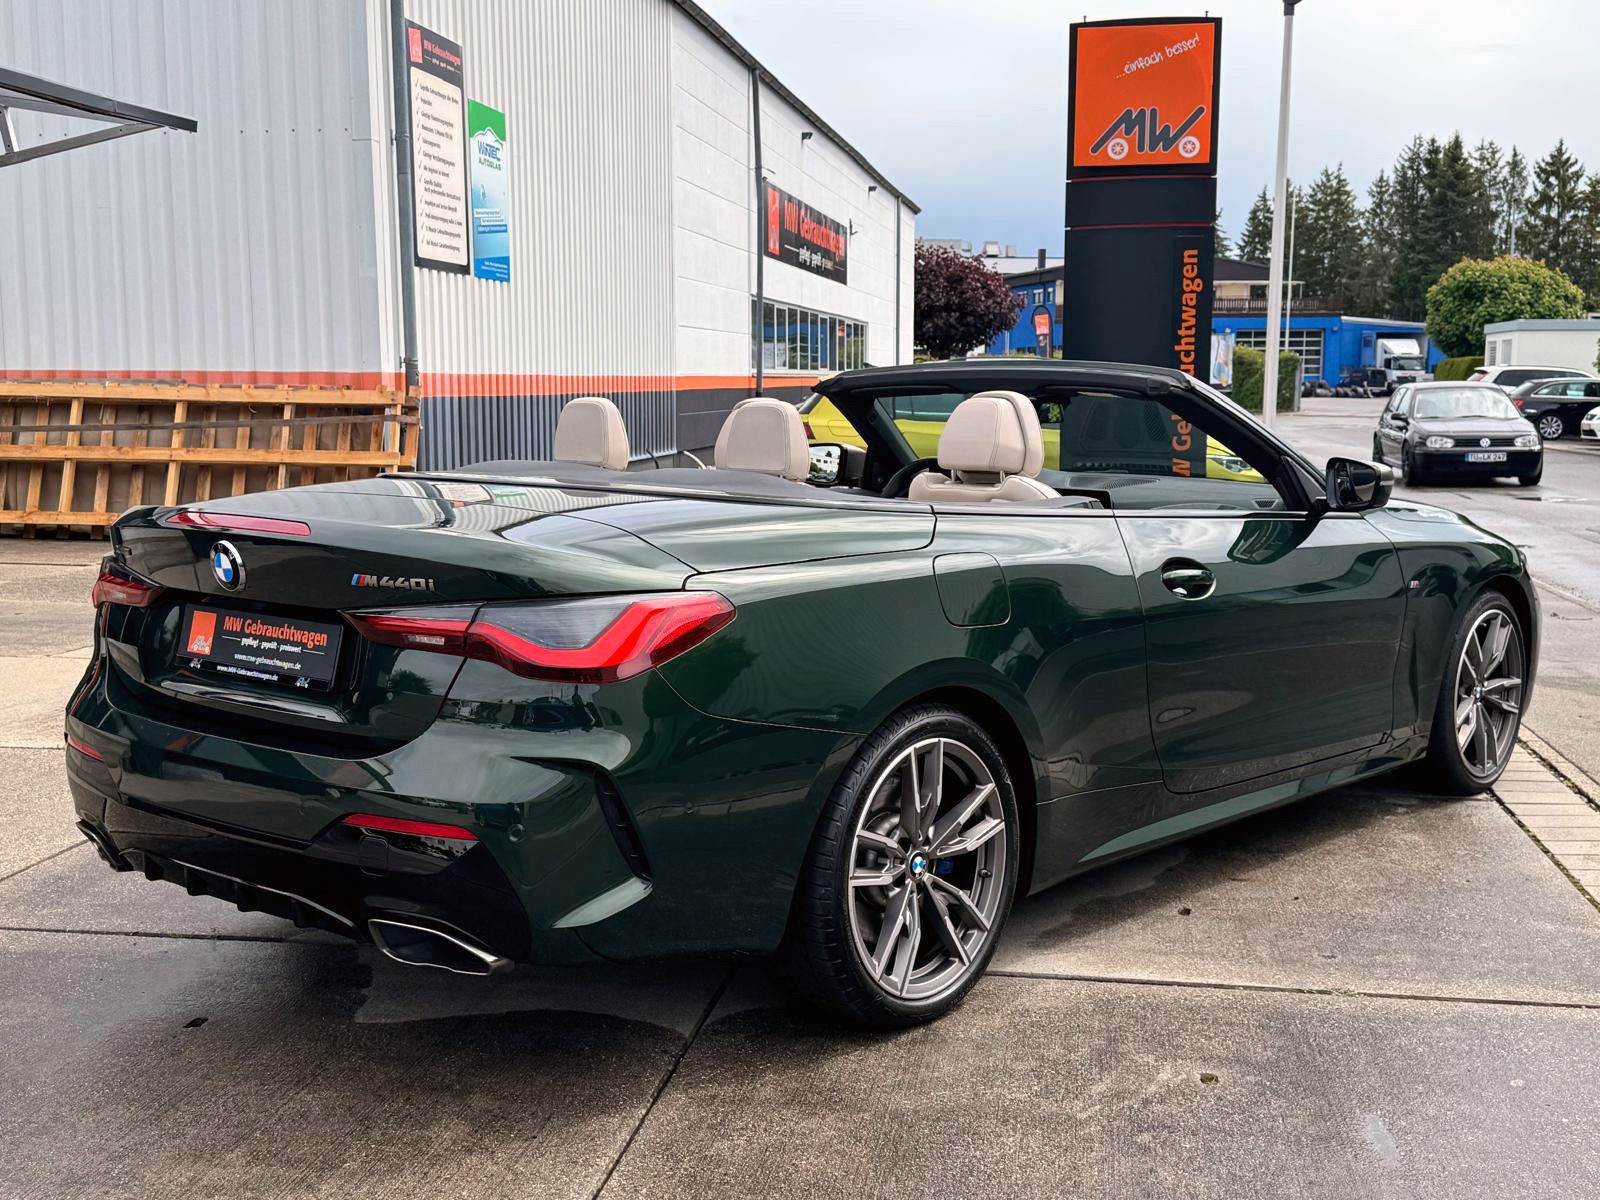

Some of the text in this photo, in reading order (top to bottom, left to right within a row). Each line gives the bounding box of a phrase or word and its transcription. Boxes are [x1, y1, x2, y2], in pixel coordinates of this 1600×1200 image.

[1089, 104, 1207, 156] MW
[364, 574, 436, 592] M440i
[223, 615, 328, 649] MW Gebrauchtwagen
